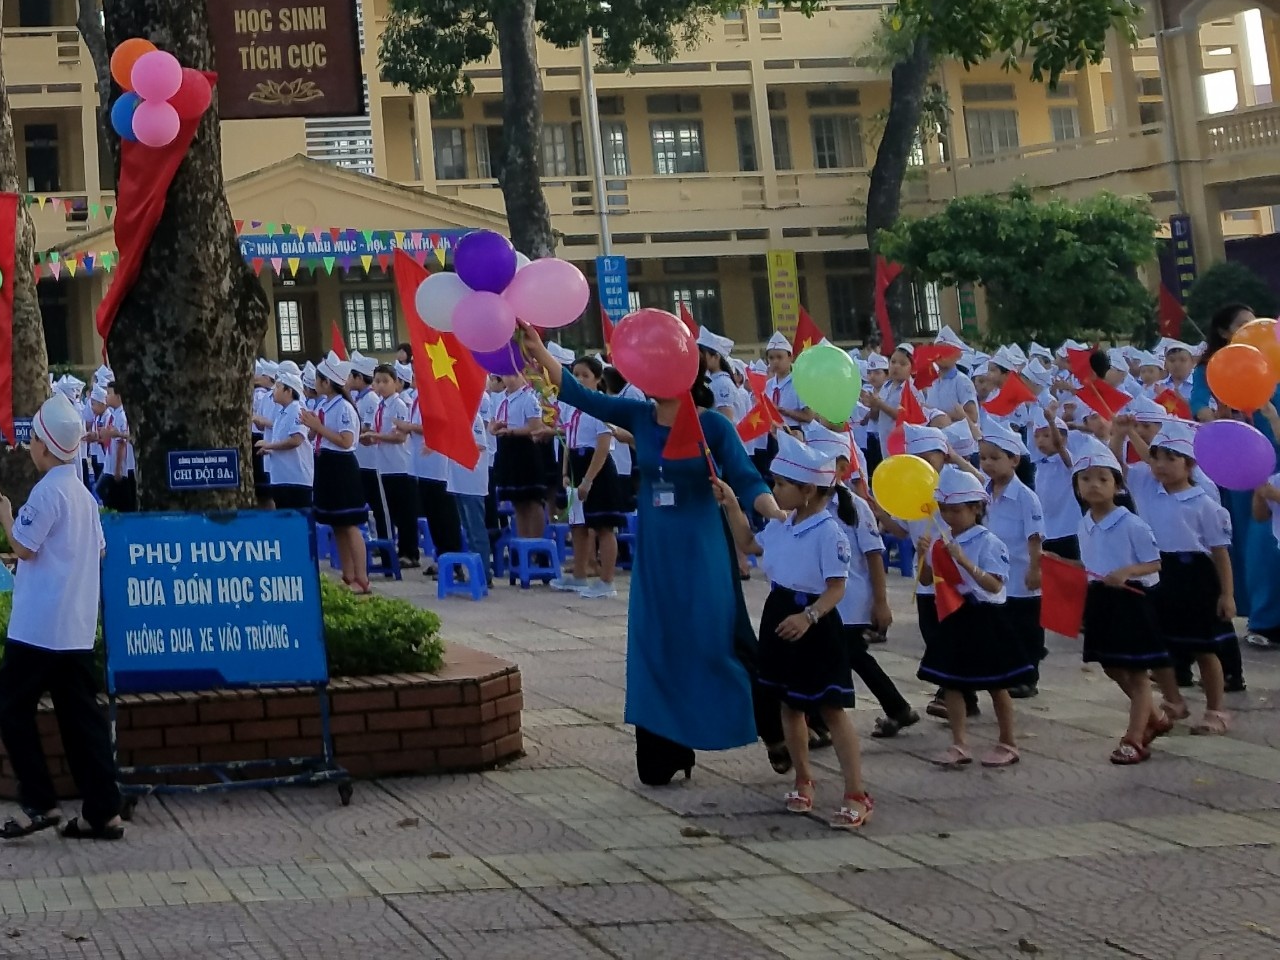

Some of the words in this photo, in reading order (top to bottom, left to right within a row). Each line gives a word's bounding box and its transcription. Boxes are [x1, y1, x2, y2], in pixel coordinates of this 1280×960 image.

[234, 9, 273, 38] HỌC
[279, 6, 327, 32] SINH
[239, 41, 282, 70] TÍCH
[288, 41, 327, 72] CỰC
[390, 237, 414, 251] SNH
[174, 469, 193, 481] CHI
[129, 542, 182, 572] PHỤ
[191, 540, 281, 564] HUYNH
[127, 576, 167, 607] ĐƯA
[173, 572, 213, 605] ĐÓN
[217, 576, 255, 610] HỌC
[260, 575, 304, 602] SINH
[126, 622, 165, 656] KHÔNG
[199, 627, 215, 652] XE
